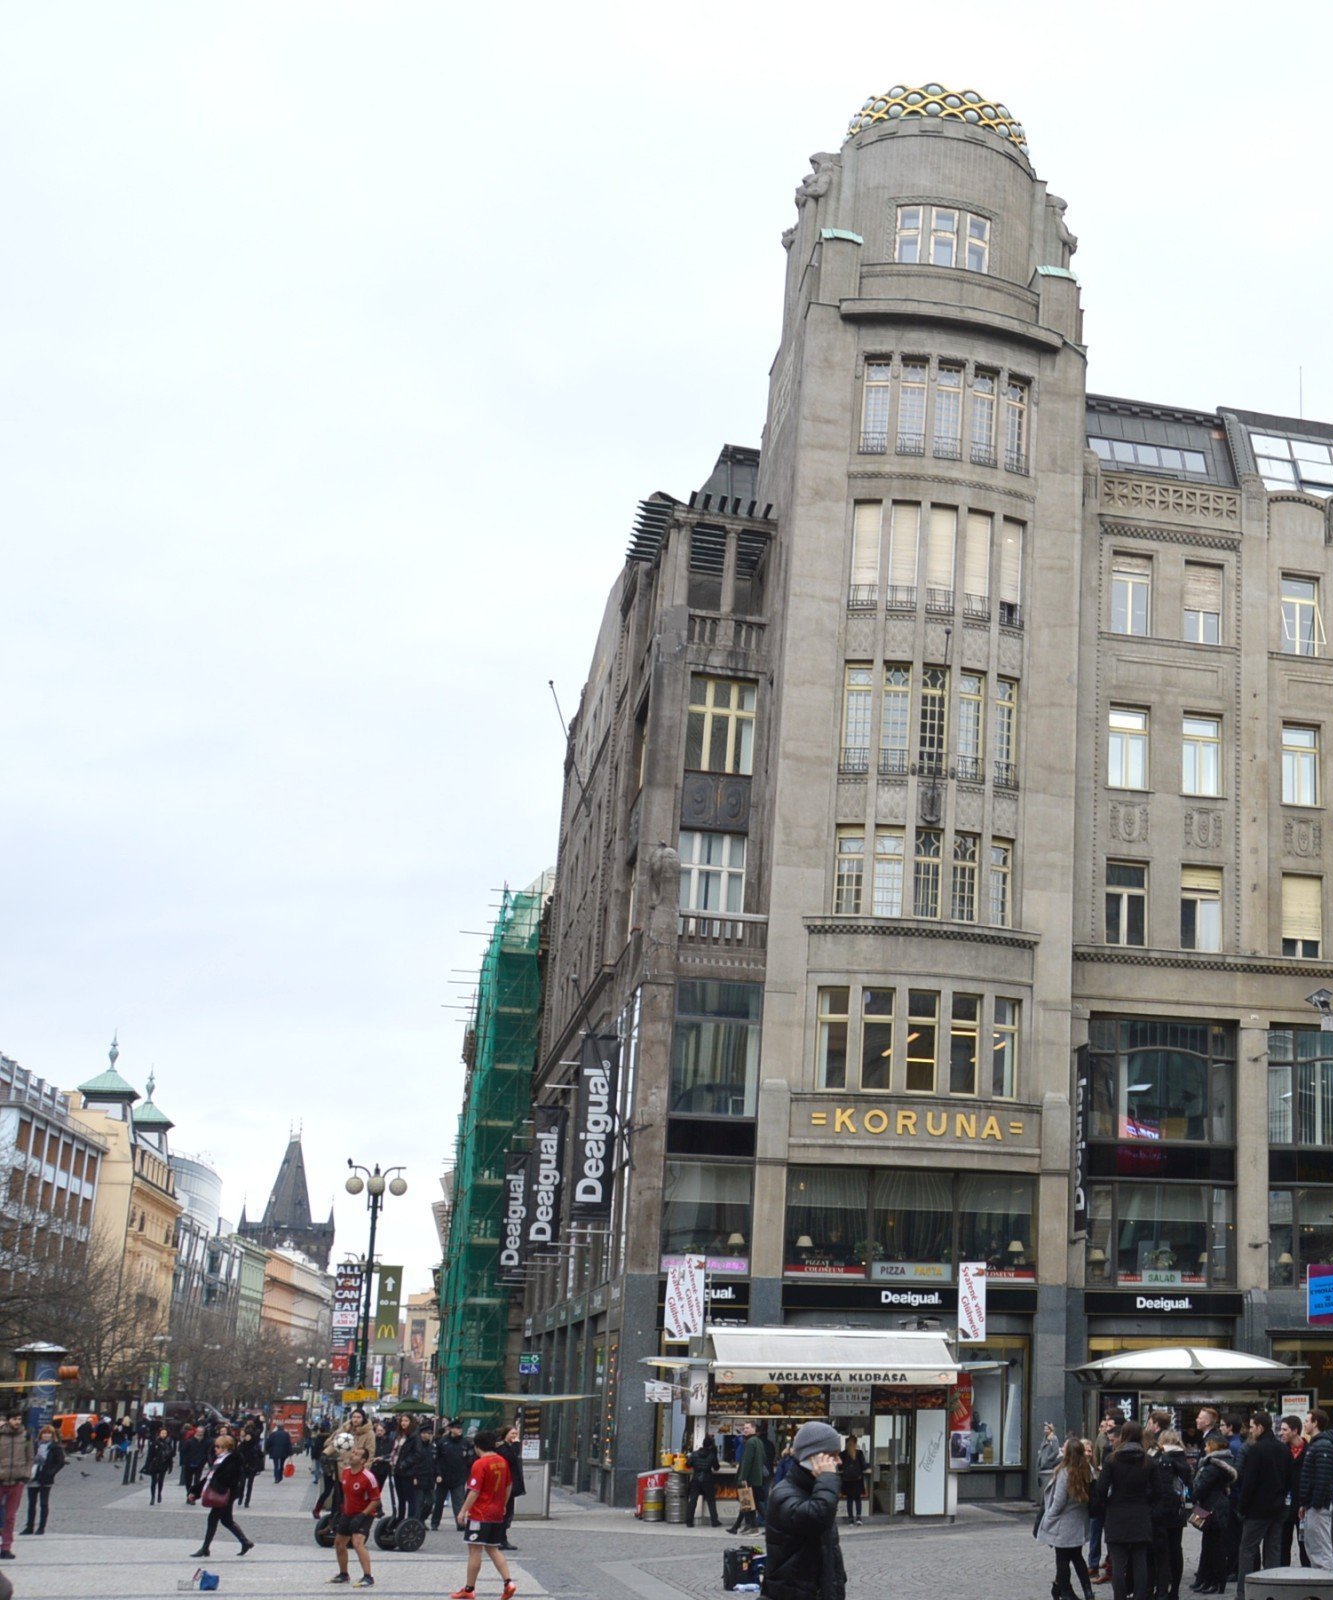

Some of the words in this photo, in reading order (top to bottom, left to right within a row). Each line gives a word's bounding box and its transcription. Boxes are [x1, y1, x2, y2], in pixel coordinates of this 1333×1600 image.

[574, 1068, 613, 1202] Desigual
[529, 1132, 560, 1241] Desigual
[500, 1174, 527, 1265] Desigual
[336, 1265, 361, 1274] ALL
[880, 1265, 906, 1276] PIZZA
[1148, 1273, 1176, 1283] SALAD
[335, 1290, 359, 1299] CAN
[881, 1290, 940, 1306] Desigual
[335, 1302, 358, 1310] EAT
[1136, 1296, 1189, 1311] Desigual
